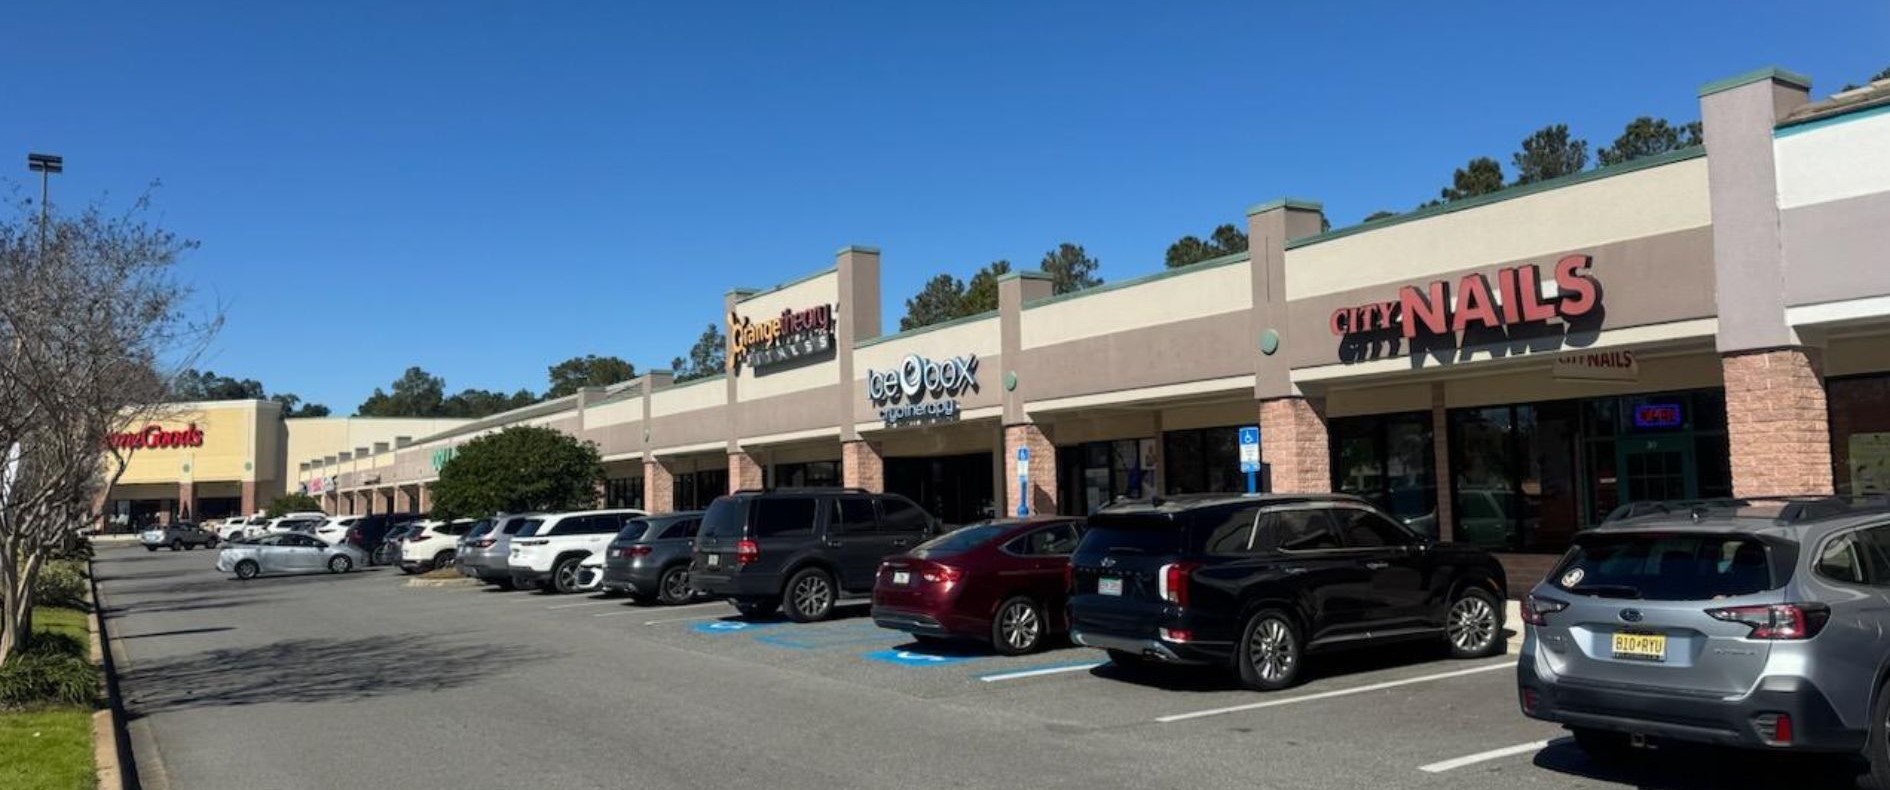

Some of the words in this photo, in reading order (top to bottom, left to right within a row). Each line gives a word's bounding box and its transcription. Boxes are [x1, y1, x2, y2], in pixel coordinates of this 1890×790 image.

[1329, 301, 1399, 337] CITY
[1398, 253, 1600, 338] NAILS
[1586, 350, 1634, 369] NAILS
